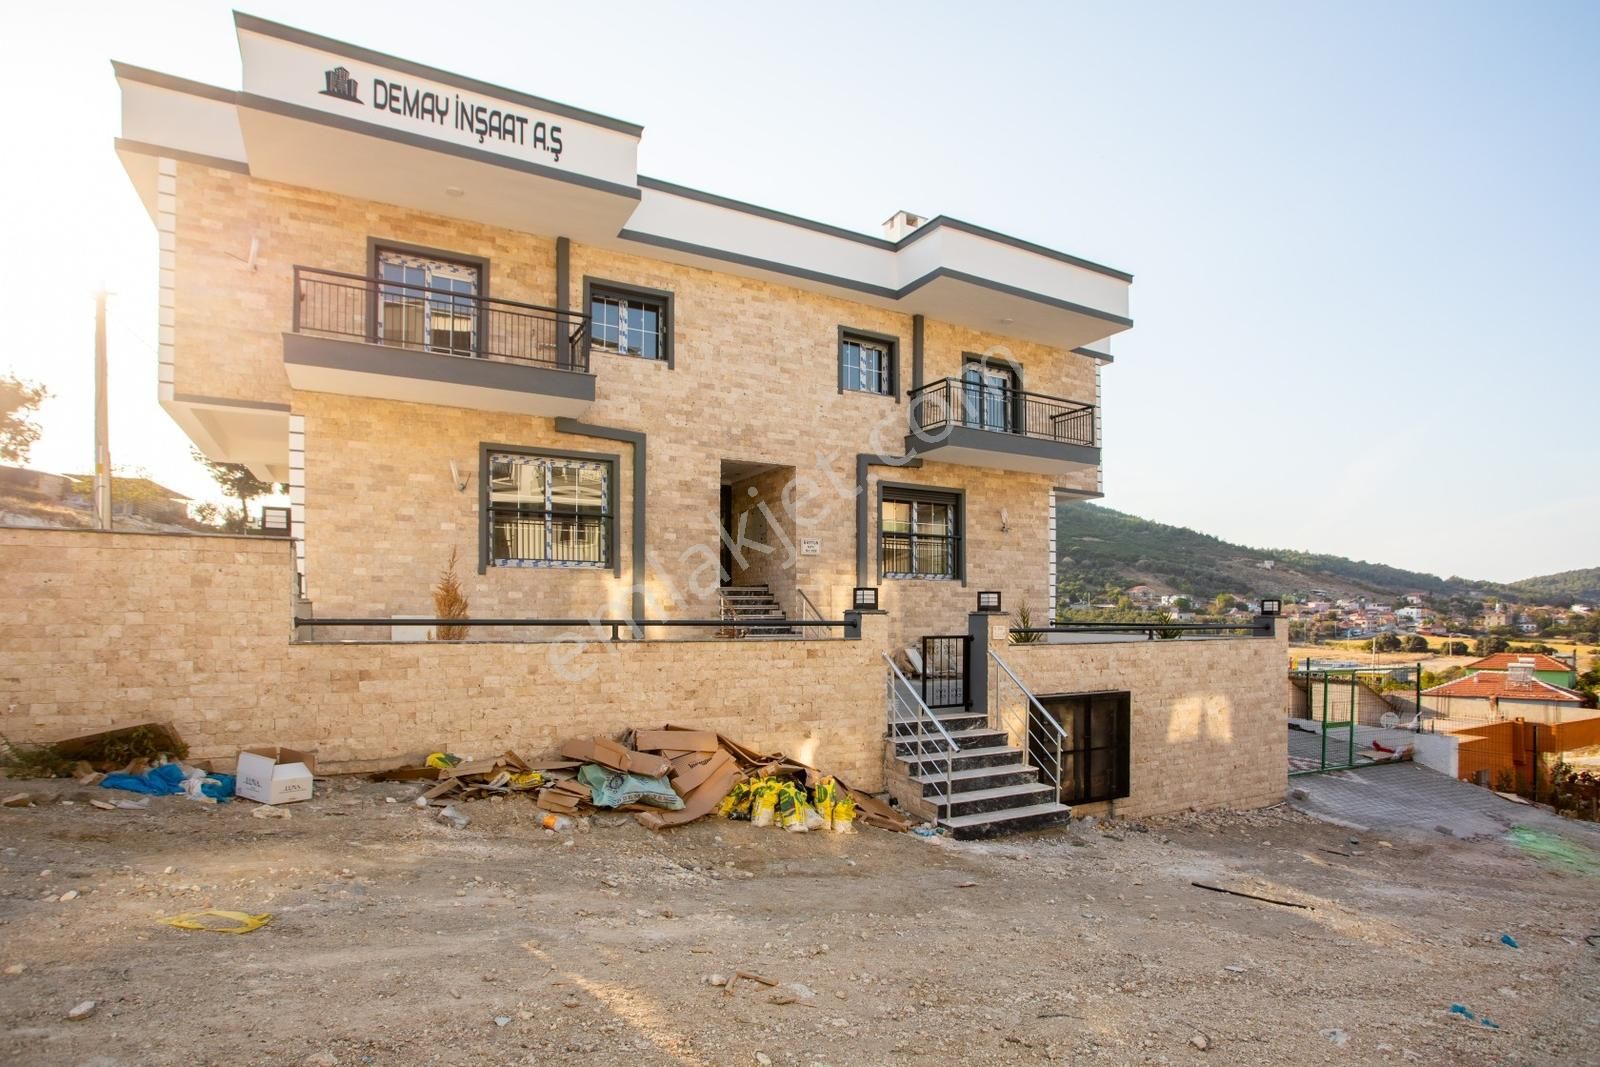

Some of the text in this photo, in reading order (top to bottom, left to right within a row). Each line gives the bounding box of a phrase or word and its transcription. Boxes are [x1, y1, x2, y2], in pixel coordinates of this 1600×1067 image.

[373, 78, 562, 162] DEMAY İNŞAAT A.Ş
